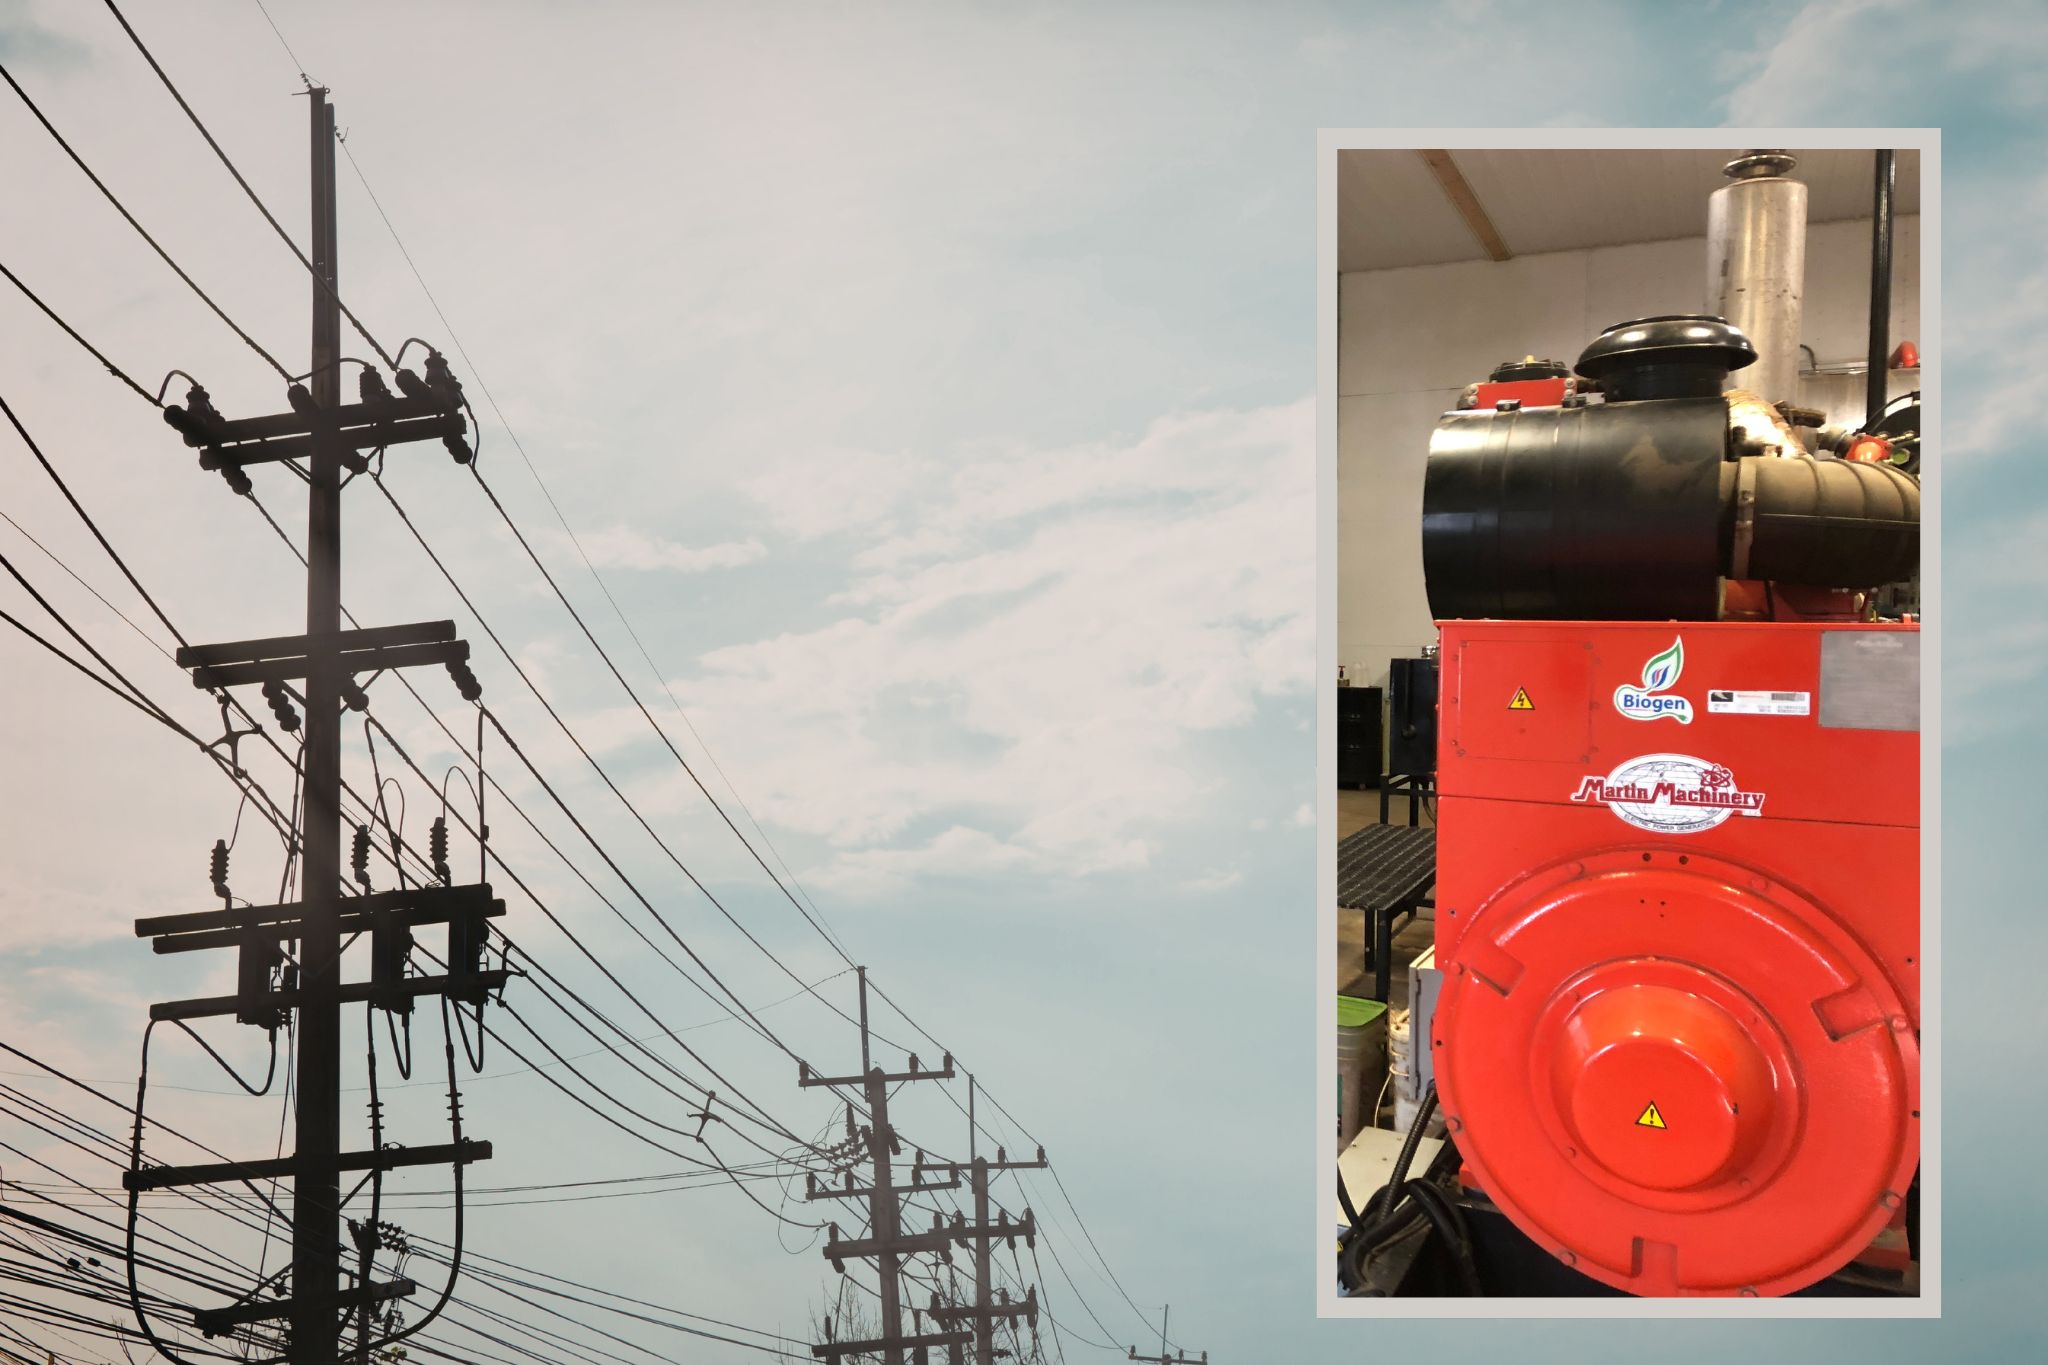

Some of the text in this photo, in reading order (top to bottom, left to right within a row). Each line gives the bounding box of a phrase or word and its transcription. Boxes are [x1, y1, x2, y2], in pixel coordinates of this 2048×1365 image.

[1623, 694, 1685, 712] Biogen
[1574, 778, 1764, 809] Martin Machinery
